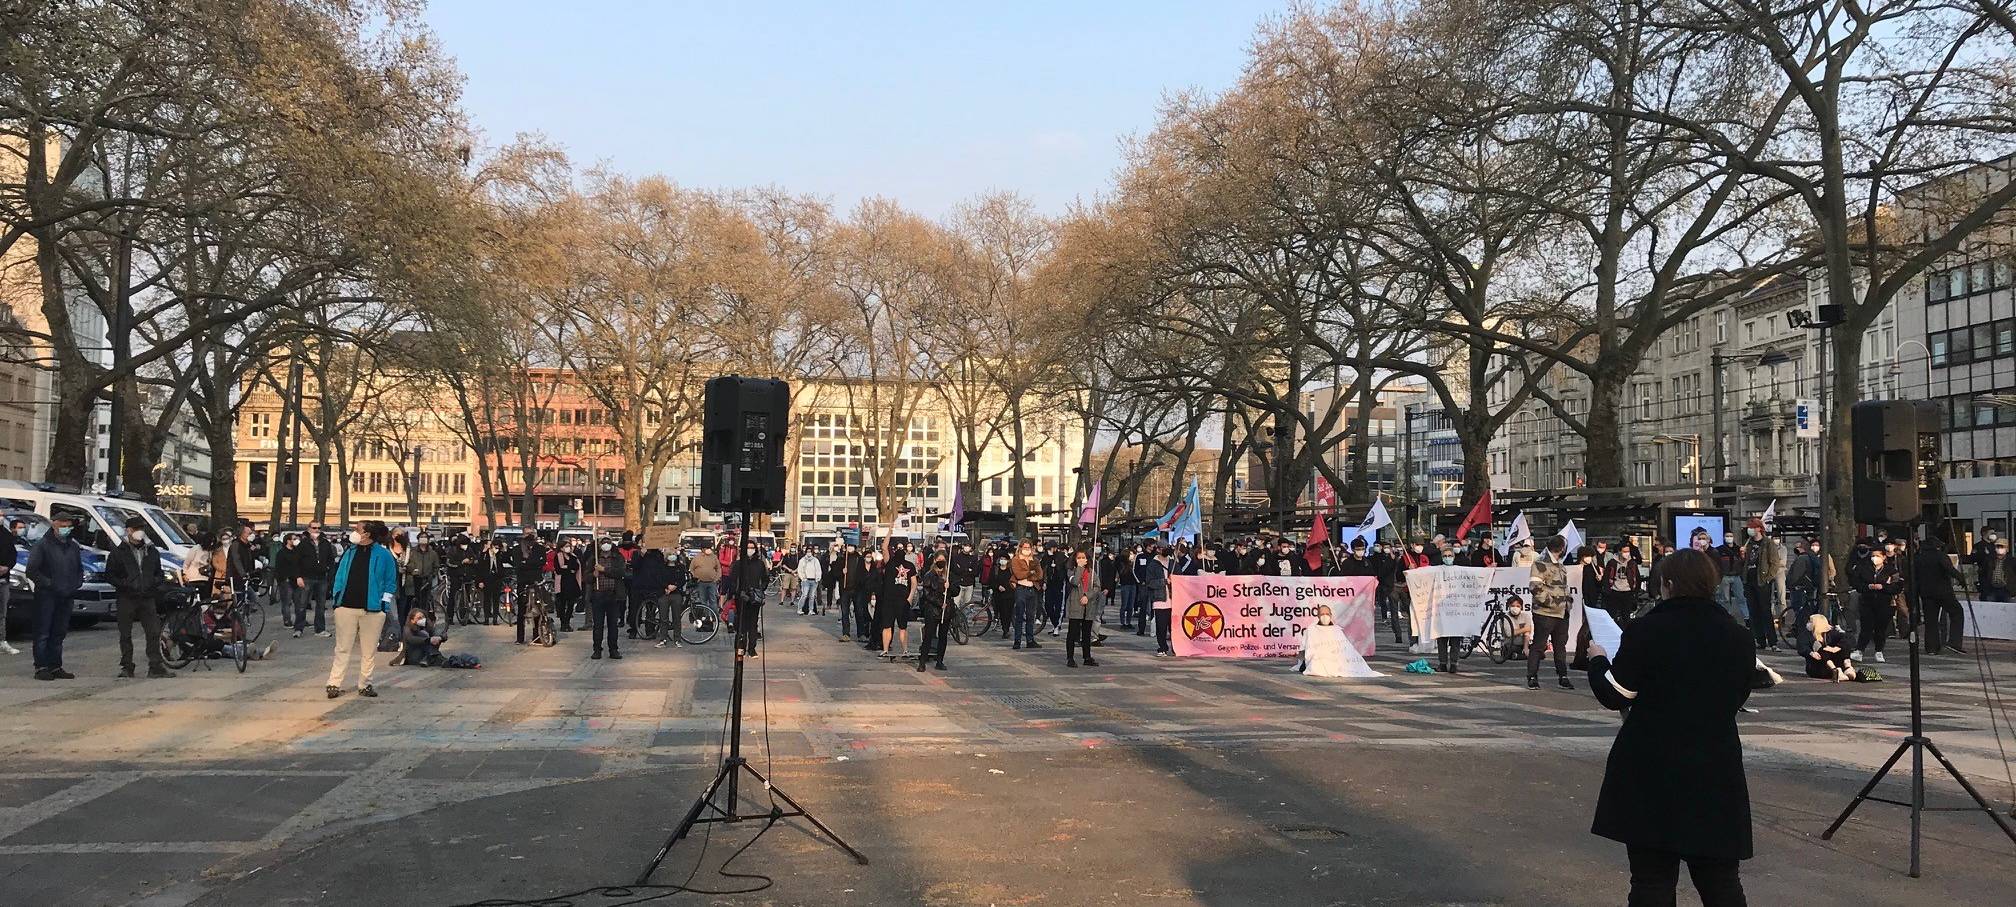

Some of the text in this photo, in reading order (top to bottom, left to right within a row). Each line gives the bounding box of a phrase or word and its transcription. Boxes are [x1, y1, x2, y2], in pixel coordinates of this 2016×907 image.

[1206, 582, 1355, 600] Die Straßen gehören
[1240, 603, 1320, 621] der Jugend
[1224, 623, 1257, 638] nicht
[1262, 624, 1286, 638] der
